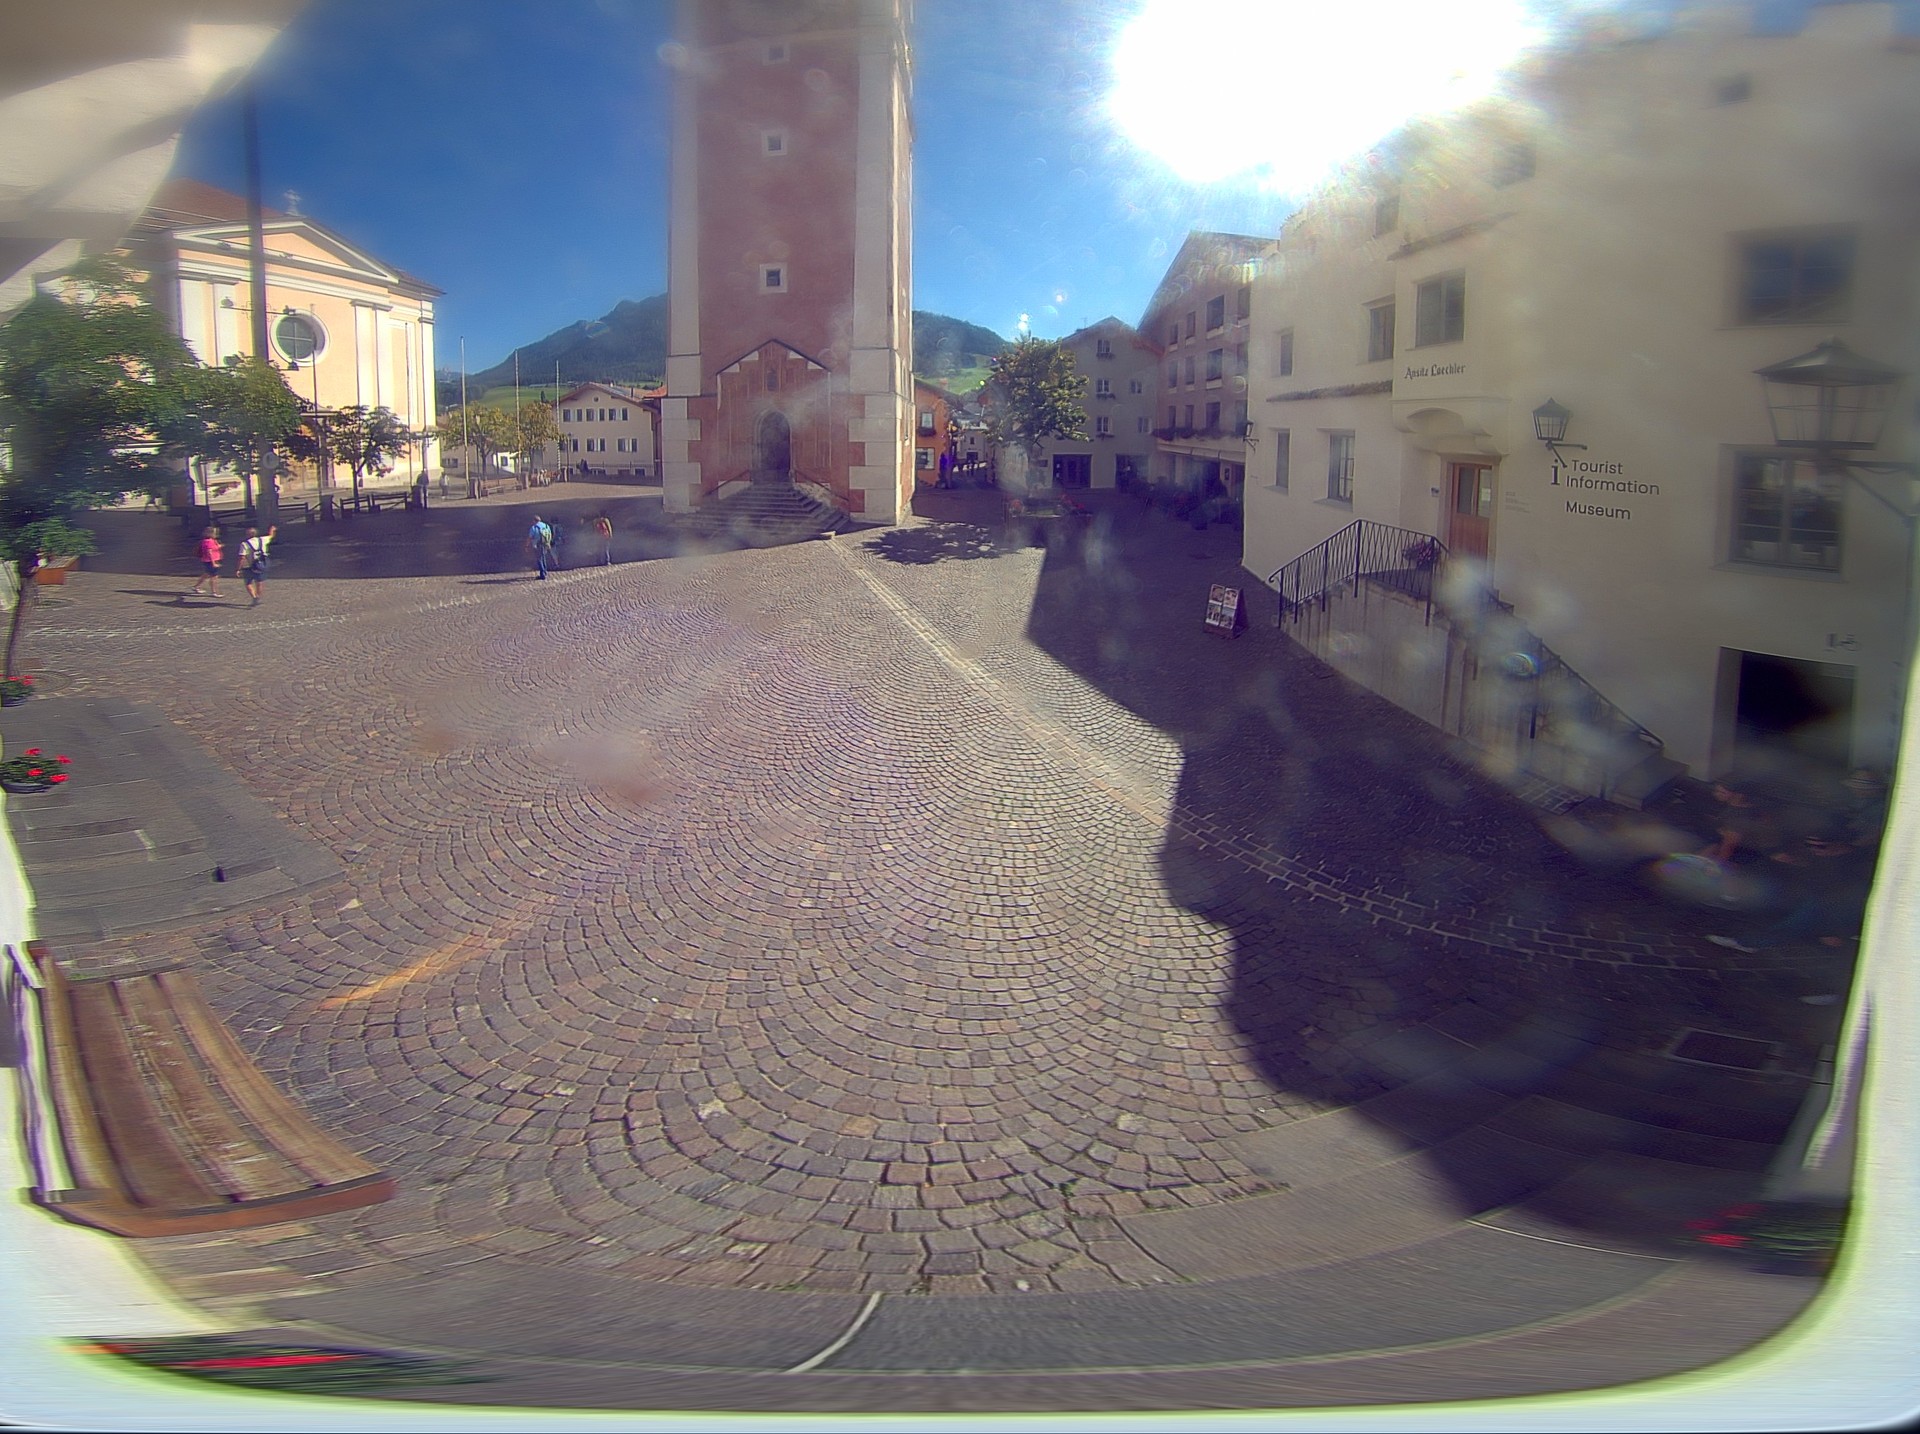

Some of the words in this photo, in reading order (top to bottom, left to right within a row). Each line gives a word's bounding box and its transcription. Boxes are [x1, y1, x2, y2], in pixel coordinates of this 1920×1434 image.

[1571, 459, 1623, 475] Tourist
[1566, 475, 1660, 495] Information
[1566, 501, 1631, 520] Museum
